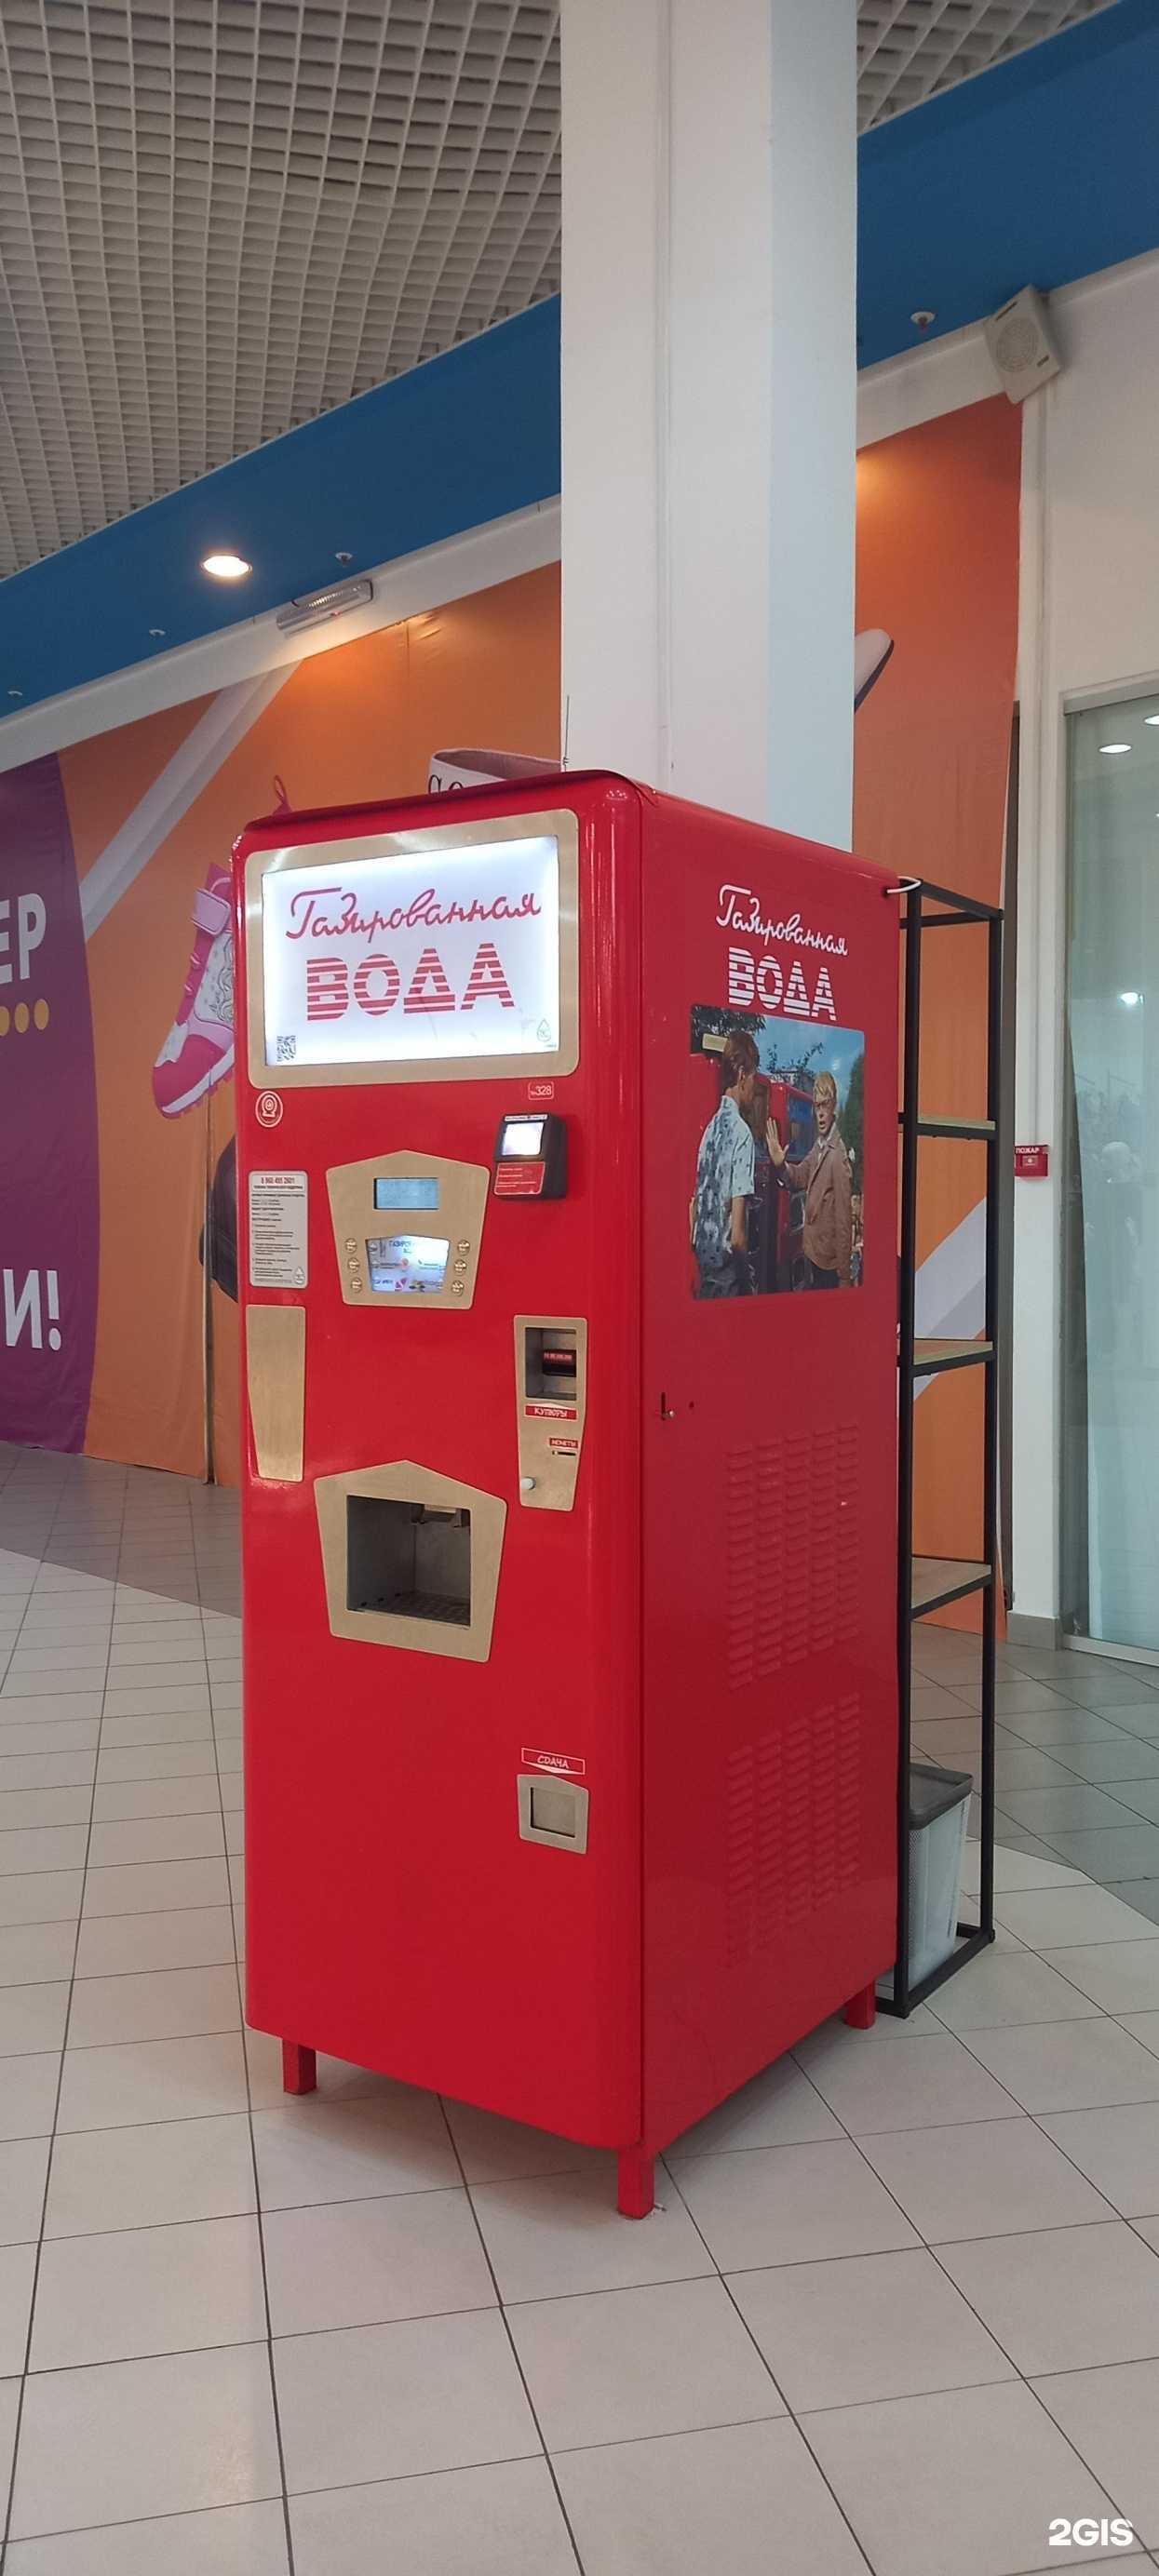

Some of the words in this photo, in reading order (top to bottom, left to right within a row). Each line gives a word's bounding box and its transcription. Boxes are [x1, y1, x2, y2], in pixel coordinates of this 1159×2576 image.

[286, 887, 542, 944] Газированная
[716, 884, 849, 957] Газированная
[306, 943, 516, 1022] ВОДА
[728, 946, 837, 1022] ВОДА
[533, 1407, 568, 1417] КУПЮРЫ
[551, 1439, 576, 1447] МОНЕТЫ
[537, 1755, 570, 1769] СДАЧА
